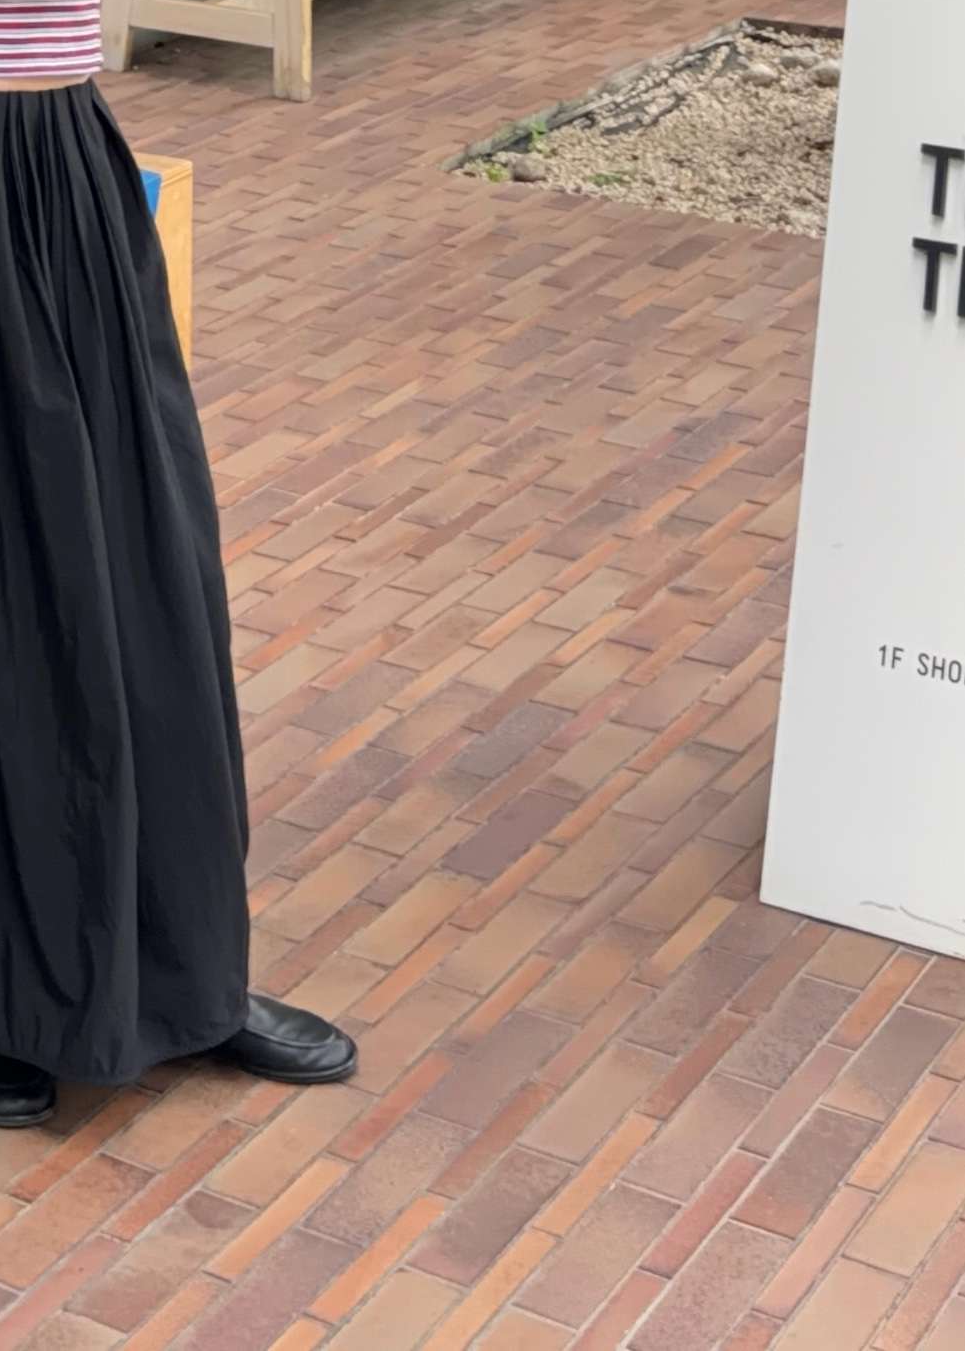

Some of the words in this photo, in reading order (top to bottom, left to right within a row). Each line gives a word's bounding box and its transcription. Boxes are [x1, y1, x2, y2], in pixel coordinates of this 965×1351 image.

[912, 236, 965, 318] T
[878, 644, 904, 669] 1F
[916, 652, 965, 686] SHO
